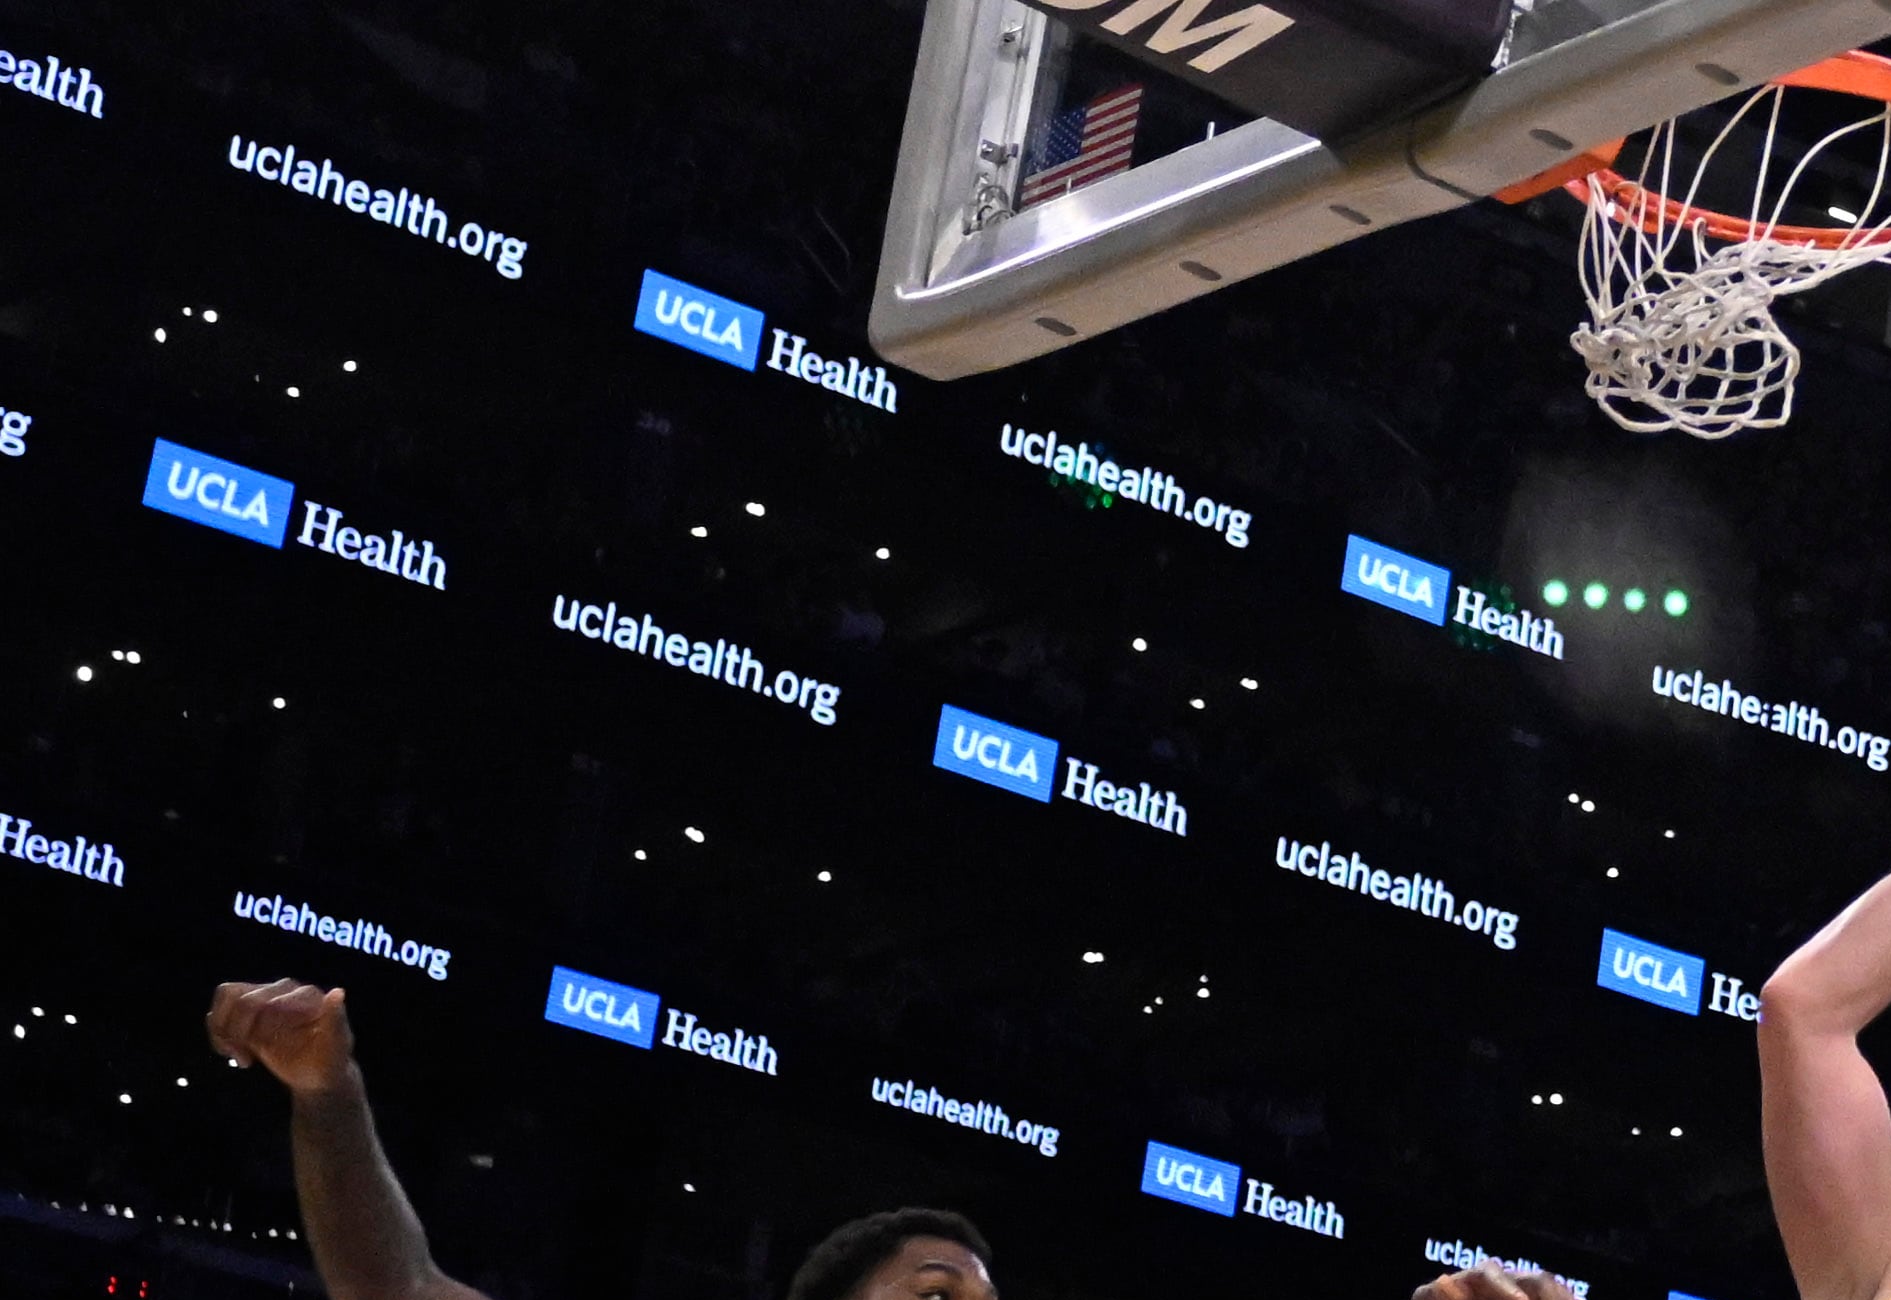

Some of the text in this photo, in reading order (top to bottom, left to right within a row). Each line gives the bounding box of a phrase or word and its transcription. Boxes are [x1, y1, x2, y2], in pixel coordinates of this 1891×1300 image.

[229, 134, 527, 279] uclahealth.org
[654, 289, 897, 413] UCLA Health
[167, 461, 446, 591] UCLA Health
[1000, 423, 1251, 548] uclahealth.org
[553, 594, 840, 726] uclahealth.org
[1358, 554, 1565, 660] UCLA Health
[1652, 665, 1891, 772] uclahealth.org
[953, 725, 1187, 836] UCLA Health
[235, 891, 452, 982] uclahealth.org
[1275, 836, 1519, 950] uclahealth.org
[1613, 947, 1687, 998] UCLA
[562, 983, 778, 1076] UCLA Health
[871, 1077, 1060, 1157] uclahealth.org
[1156, 1156, 1344, 1239] UCLA Health
